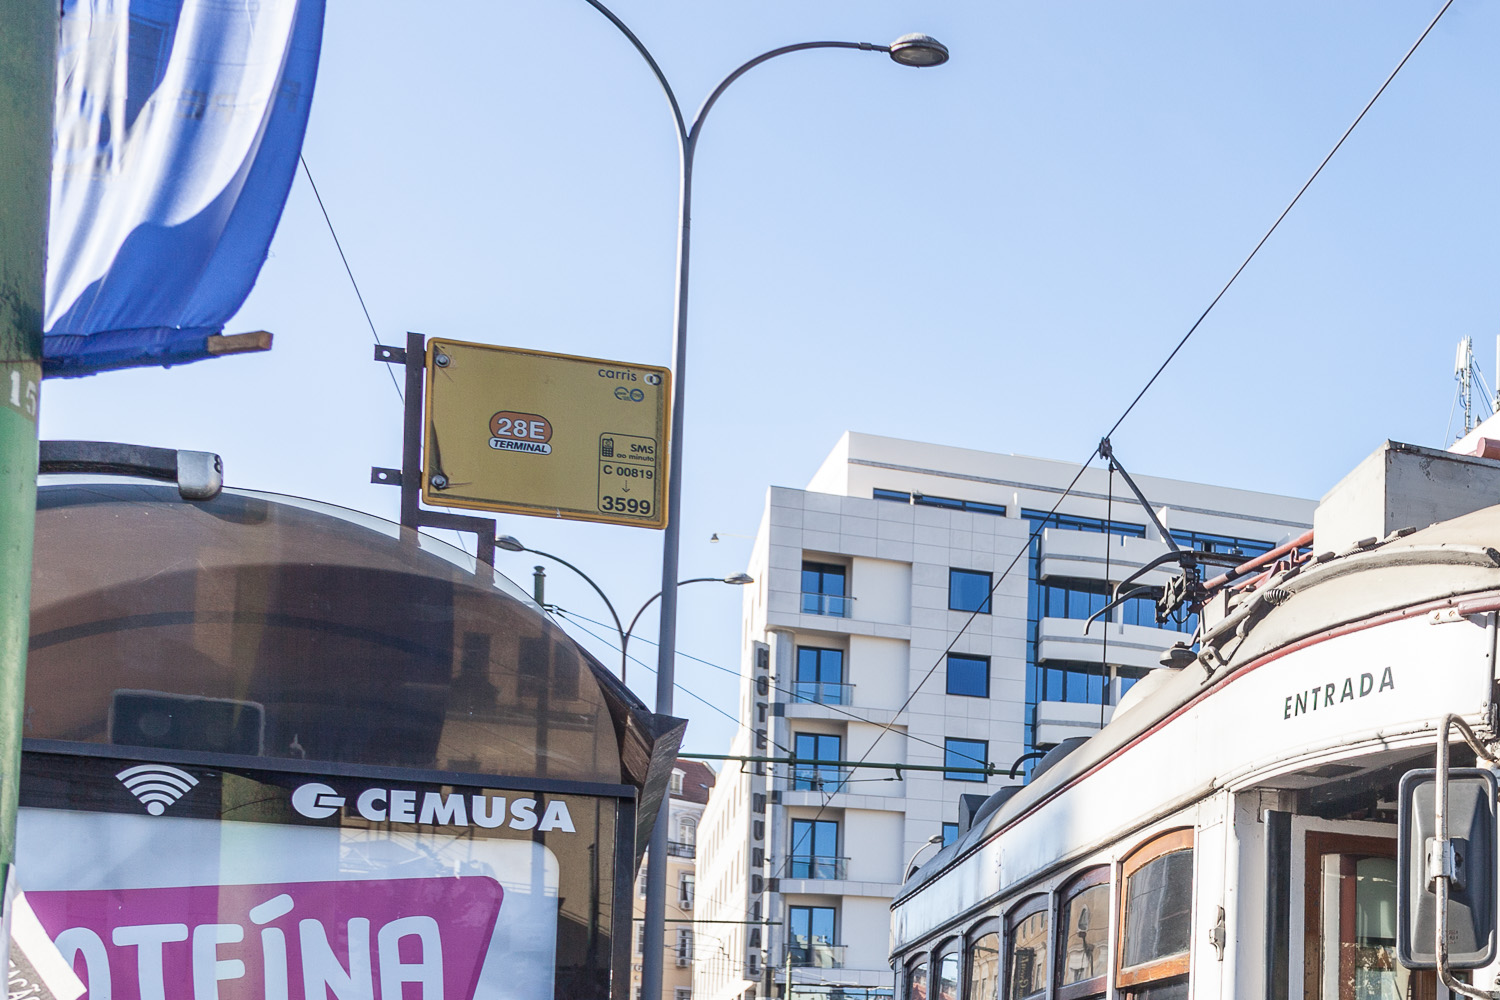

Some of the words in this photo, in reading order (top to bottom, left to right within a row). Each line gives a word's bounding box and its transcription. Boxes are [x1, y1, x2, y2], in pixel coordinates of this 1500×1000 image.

[598, 369, 637, 382] carris
[497, 417, 546, 440] 28E
[493, 439, 548, 454] TERMINAL
[630, 443, 654, 454] SMS
[629, 453, 655, 462] minuto
[603, 464, 613, 475] C
[616, 467, 653, 480] 00819
[602, 495, 651, 515] 3599
[1284, 666, 1395, 721] ENTRADA
[756, 648, 770, 776] HOTEL
[357, 787, 577, 833] CEMUSA
[749, 792, 767, 976] MUNDIAL
